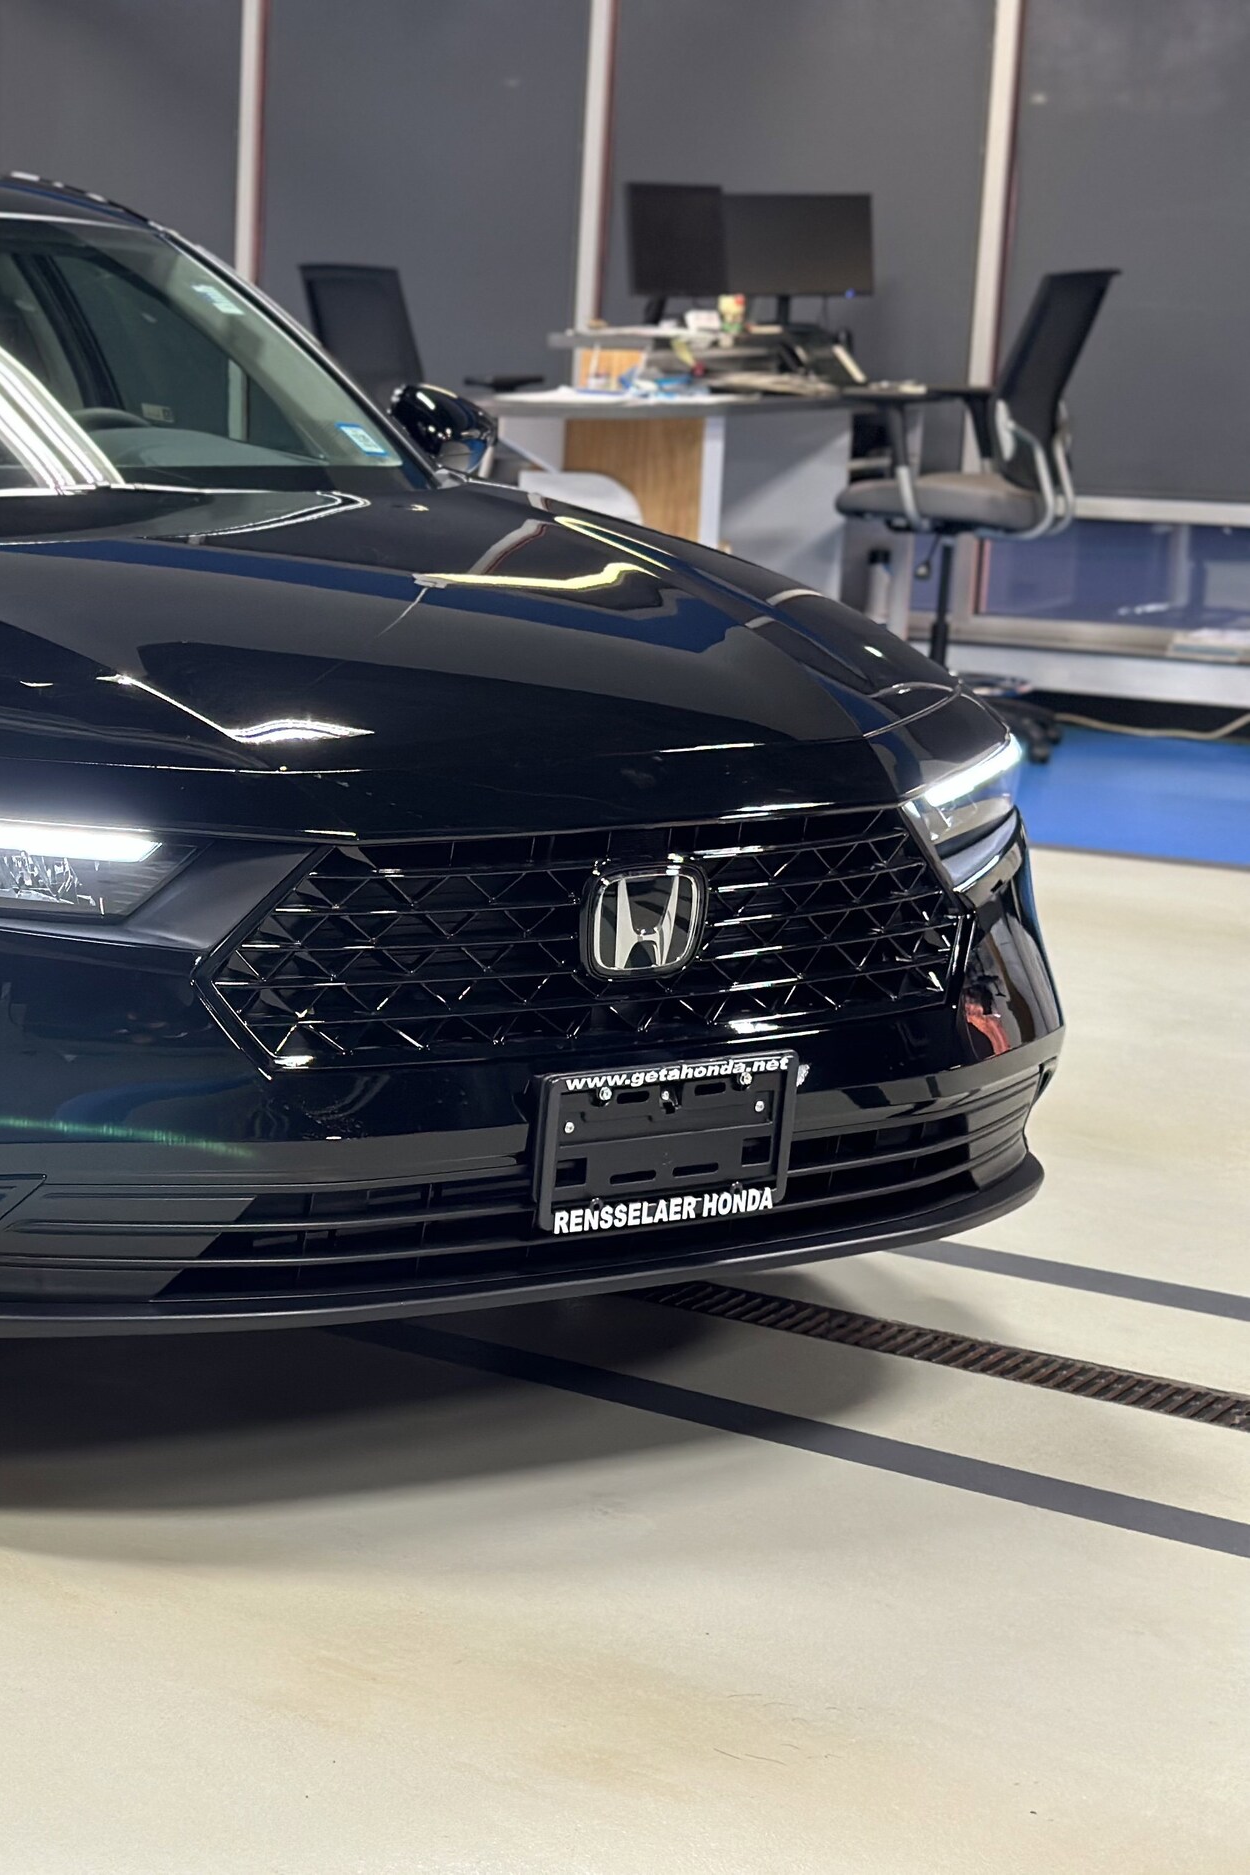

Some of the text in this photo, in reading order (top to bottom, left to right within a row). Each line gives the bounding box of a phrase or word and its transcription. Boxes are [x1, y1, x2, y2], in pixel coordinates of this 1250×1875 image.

[565, 1056, 789, 1091] www.getahonda.net
[553, 1186, 773, 1235] RENSSELAER HONDA
